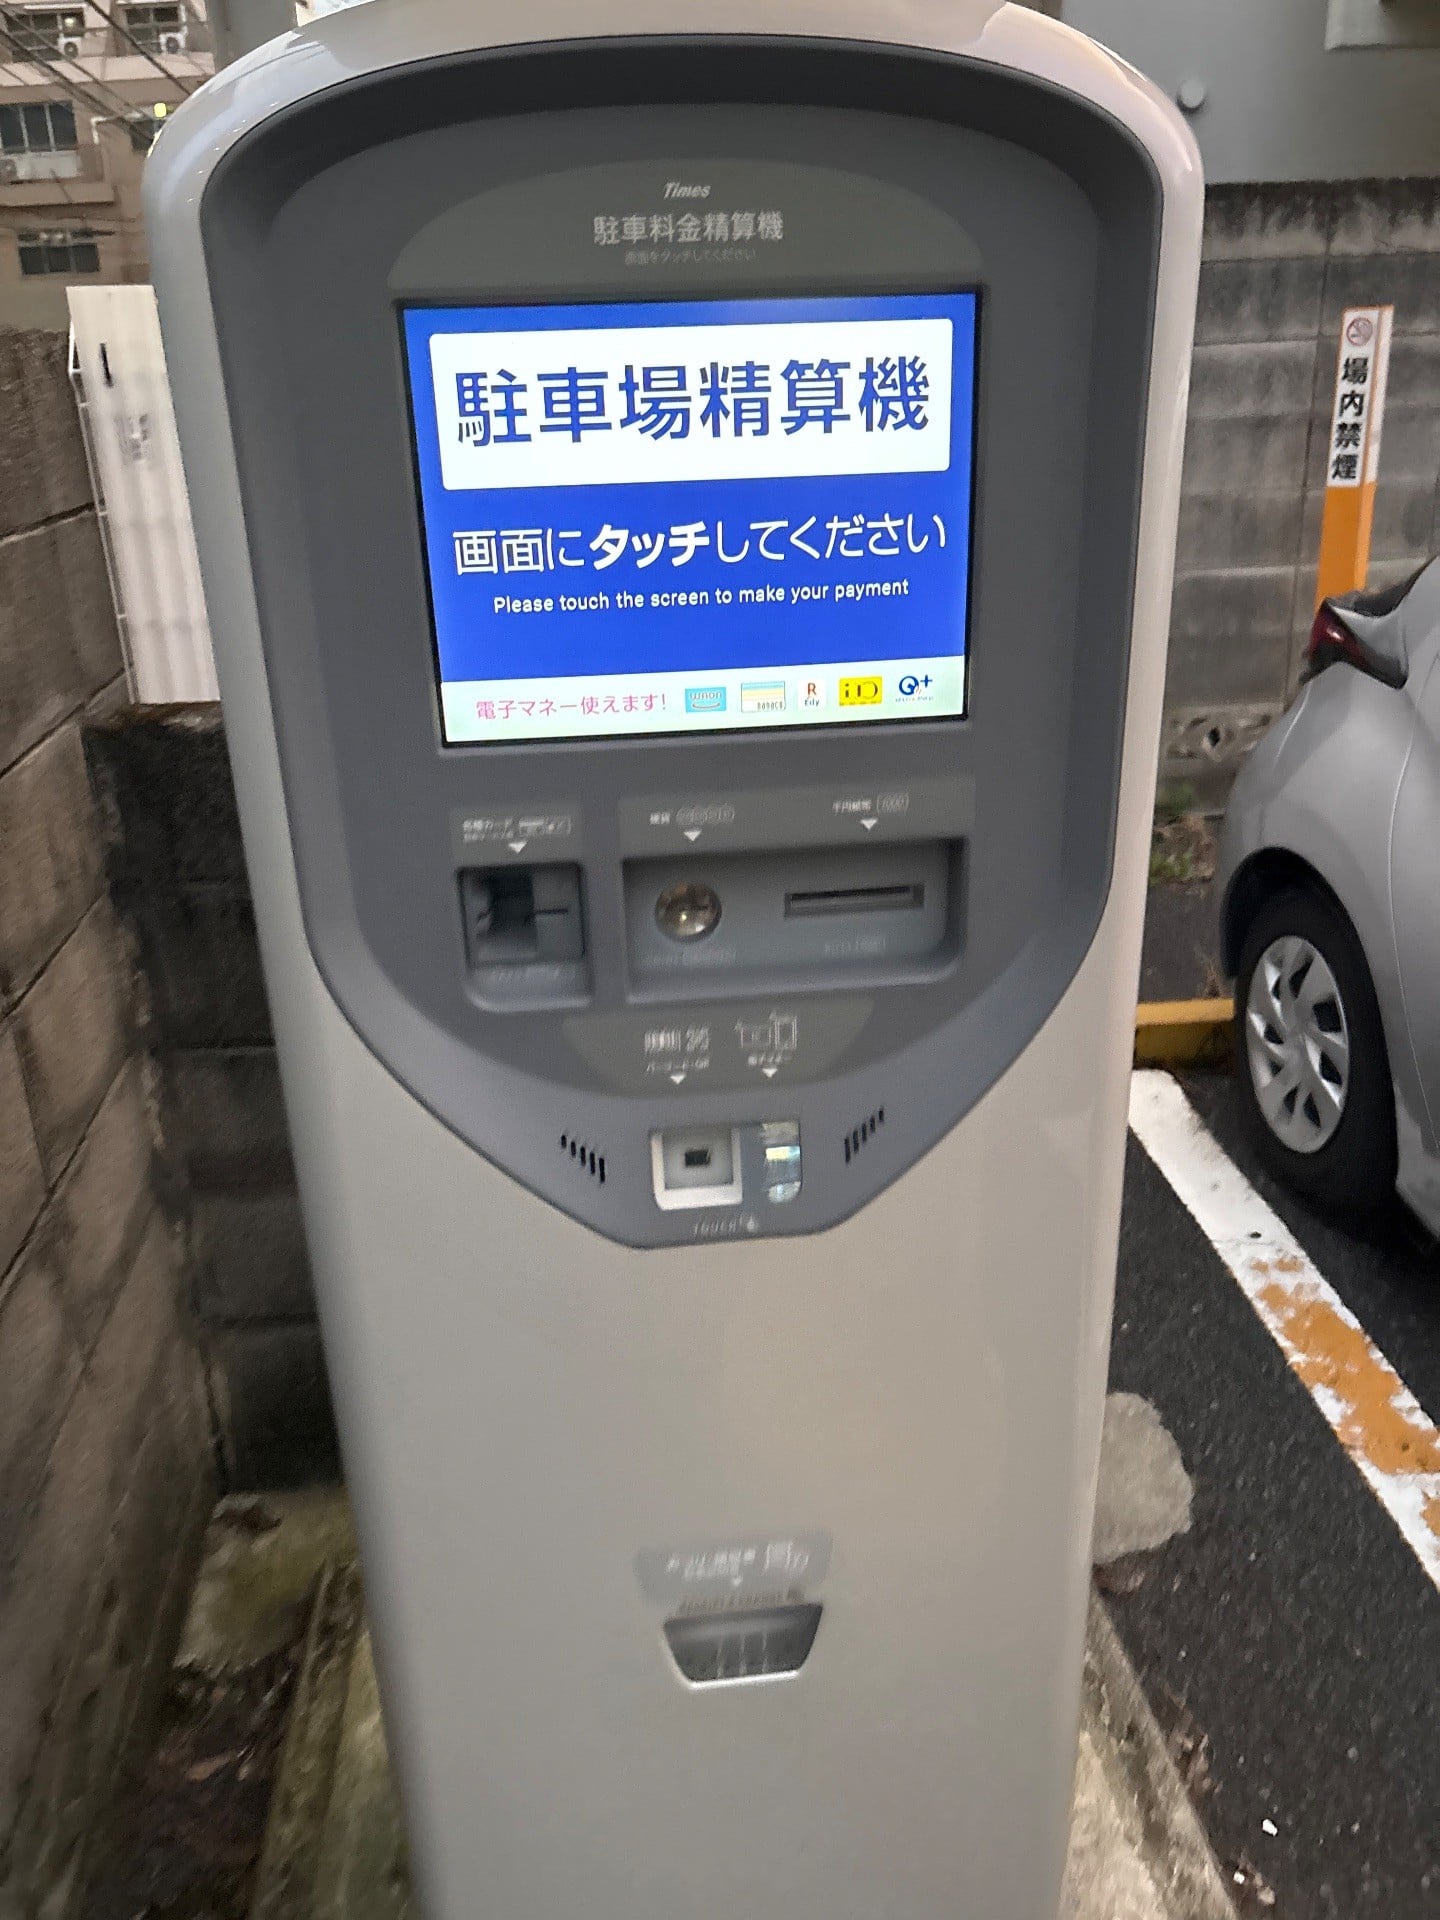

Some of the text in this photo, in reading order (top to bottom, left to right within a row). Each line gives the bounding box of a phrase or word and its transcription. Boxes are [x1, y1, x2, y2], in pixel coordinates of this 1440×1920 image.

[663, 182, 712, 200] Times
[593, 211, 784, 245] 駐車料金精算機
[455, 355, 930, 447] 駐車場精算機
[1332, 357, 1368, 480] 場内禁煙
[453, 512, 947, 576] 画面にタッチしてください
[493, 578, 909, 614] Please touch the screen to make your payment
[476, 693, 667, 720] 電子マネー使えます!
